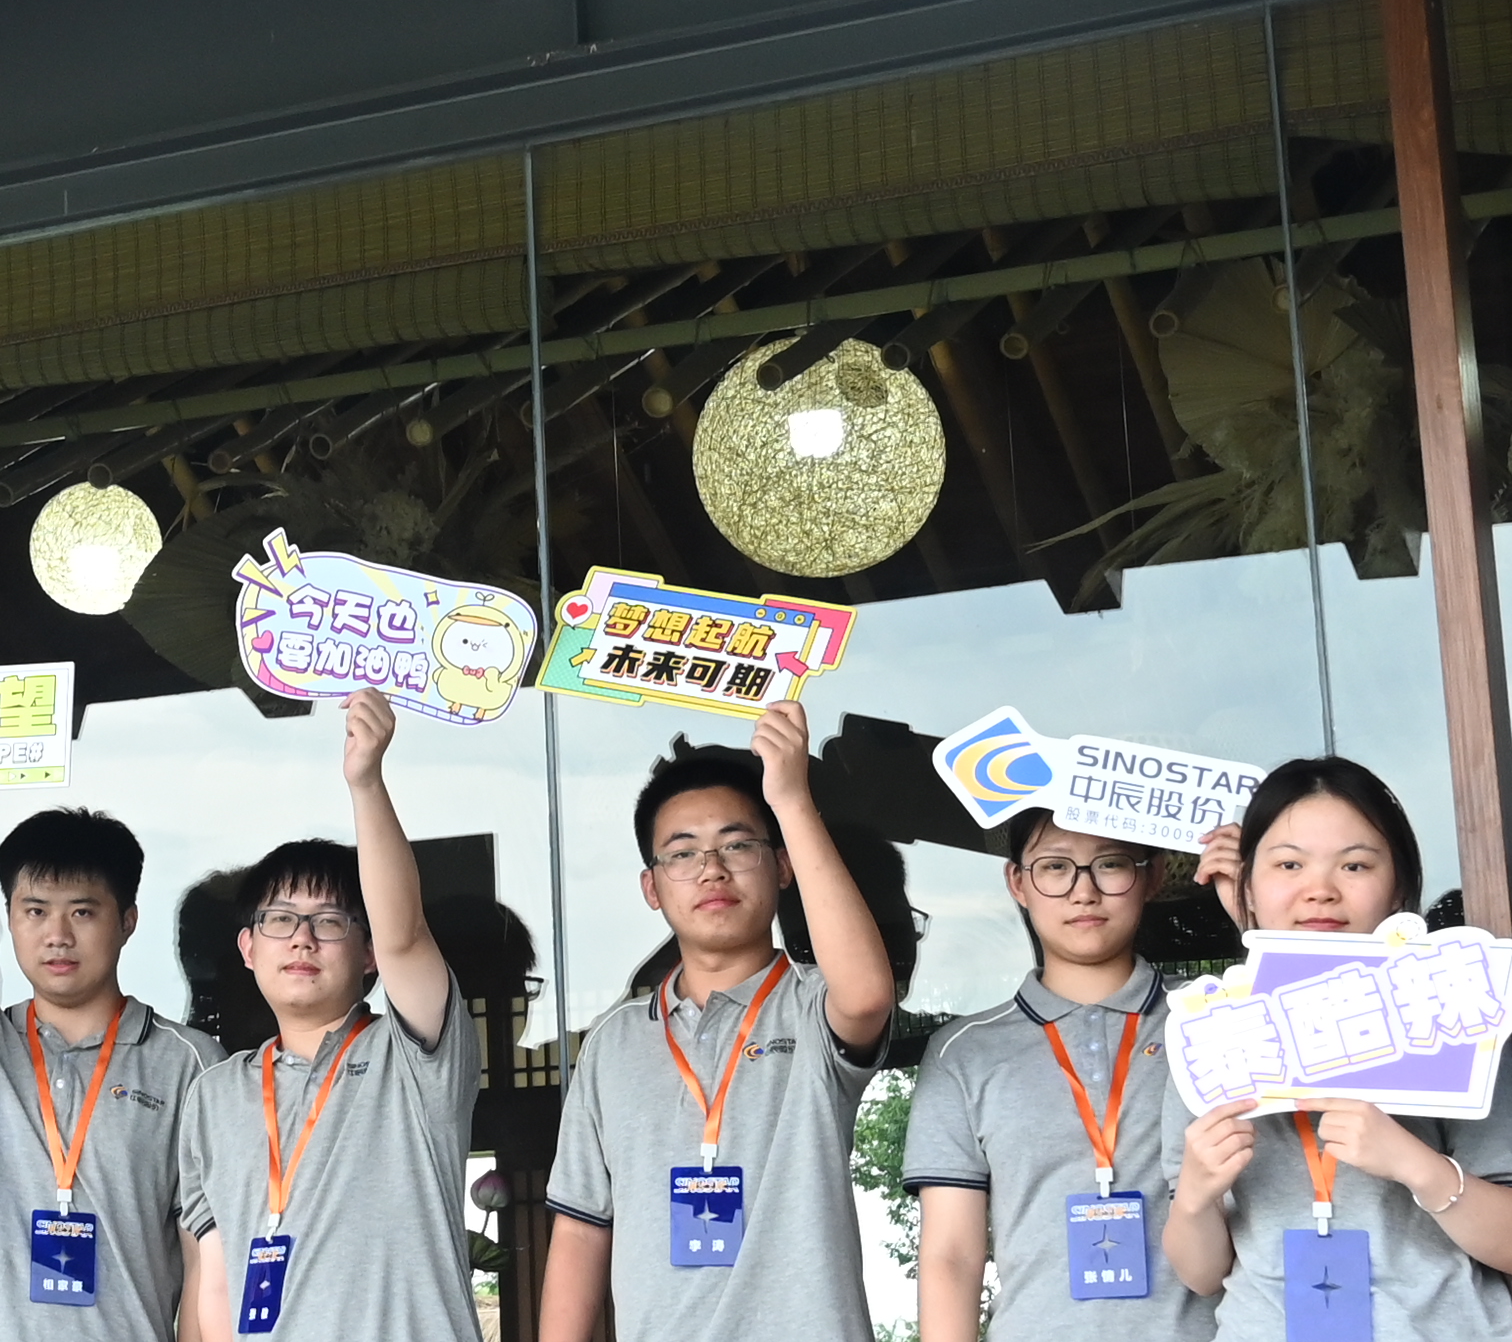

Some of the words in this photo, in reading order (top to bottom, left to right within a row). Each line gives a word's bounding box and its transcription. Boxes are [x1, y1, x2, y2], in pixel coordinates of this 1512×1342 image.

[287, 583, 418, 643] 今天也
[603, 601, 777, 660] 梦想起航
[276, 631, 429, 692] 要加油鸭
[600, 644, 775, 700] 未来可期
[1077, 744, 1261, 797] SINOSTAR
[1065, 806, 1205, 843] 股票代码:3009
[1069, 775, 1226, 829] 中辰股份
[1180, 940, 1506, 1104] 泰酷辣
